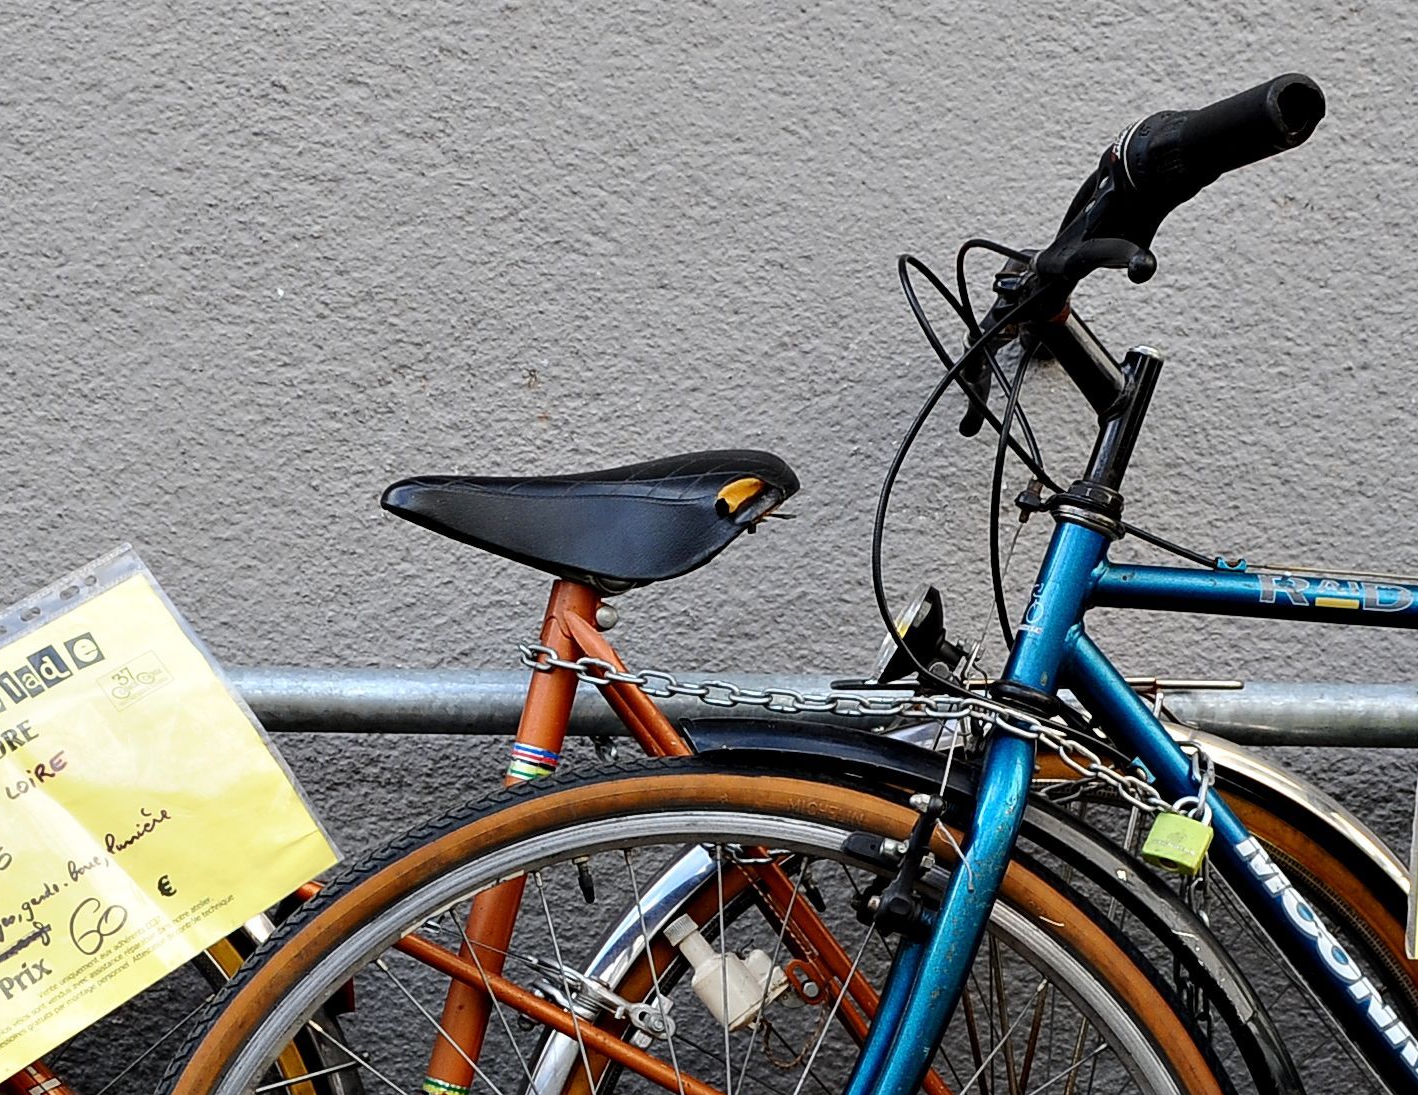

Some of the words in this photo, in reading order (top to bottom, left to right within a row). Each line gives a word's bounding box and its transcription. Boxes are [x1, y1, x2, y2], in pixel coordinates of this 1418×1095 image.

[1258, 574, 1414, 613] RAID
[68, 897, 127, 955] 60
[157, 874, 177, 897] €
